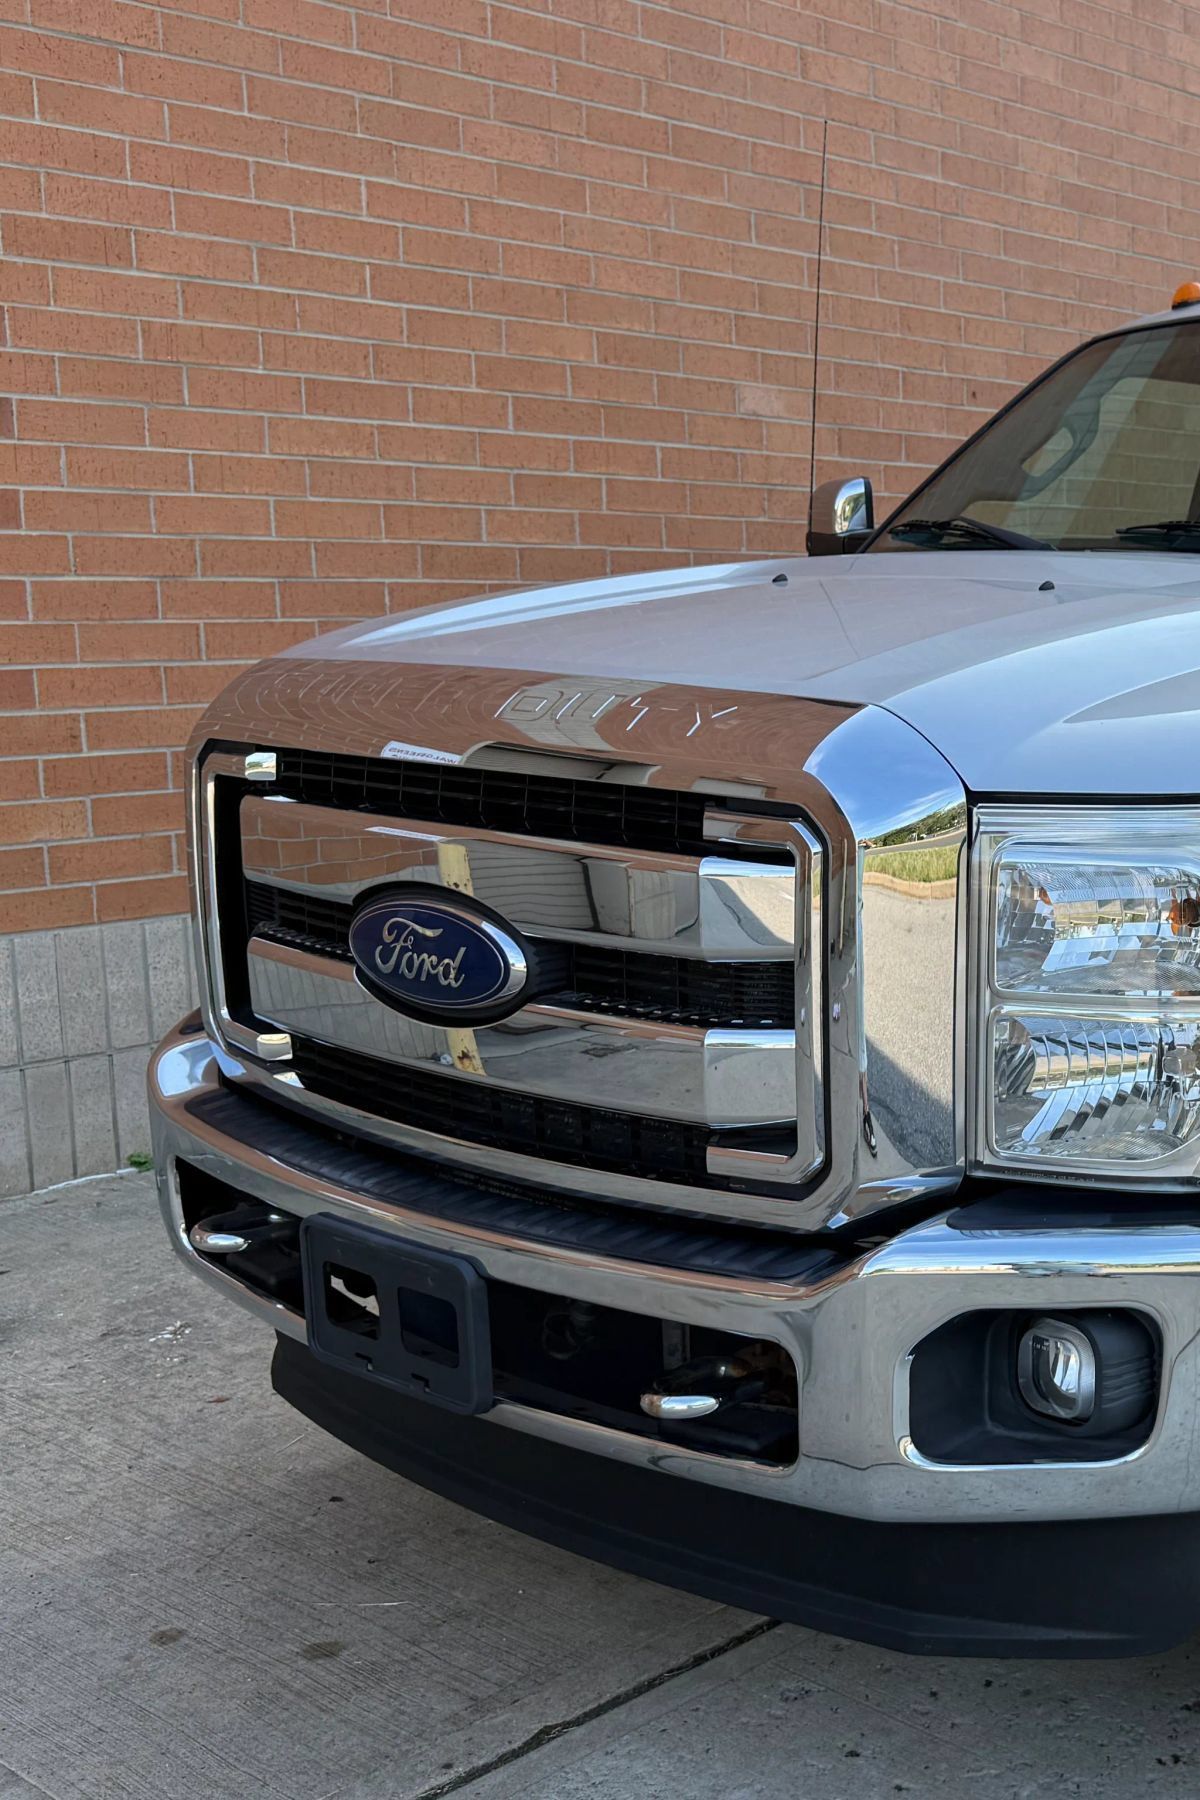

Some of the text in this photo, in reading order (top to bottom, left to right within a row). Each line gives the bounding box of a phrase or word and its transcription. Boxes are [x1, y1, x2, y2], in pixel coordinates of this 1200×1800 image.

[259, 670, 739, 737] SUPER DUTY
[374, 916, 468, 988] Ford
